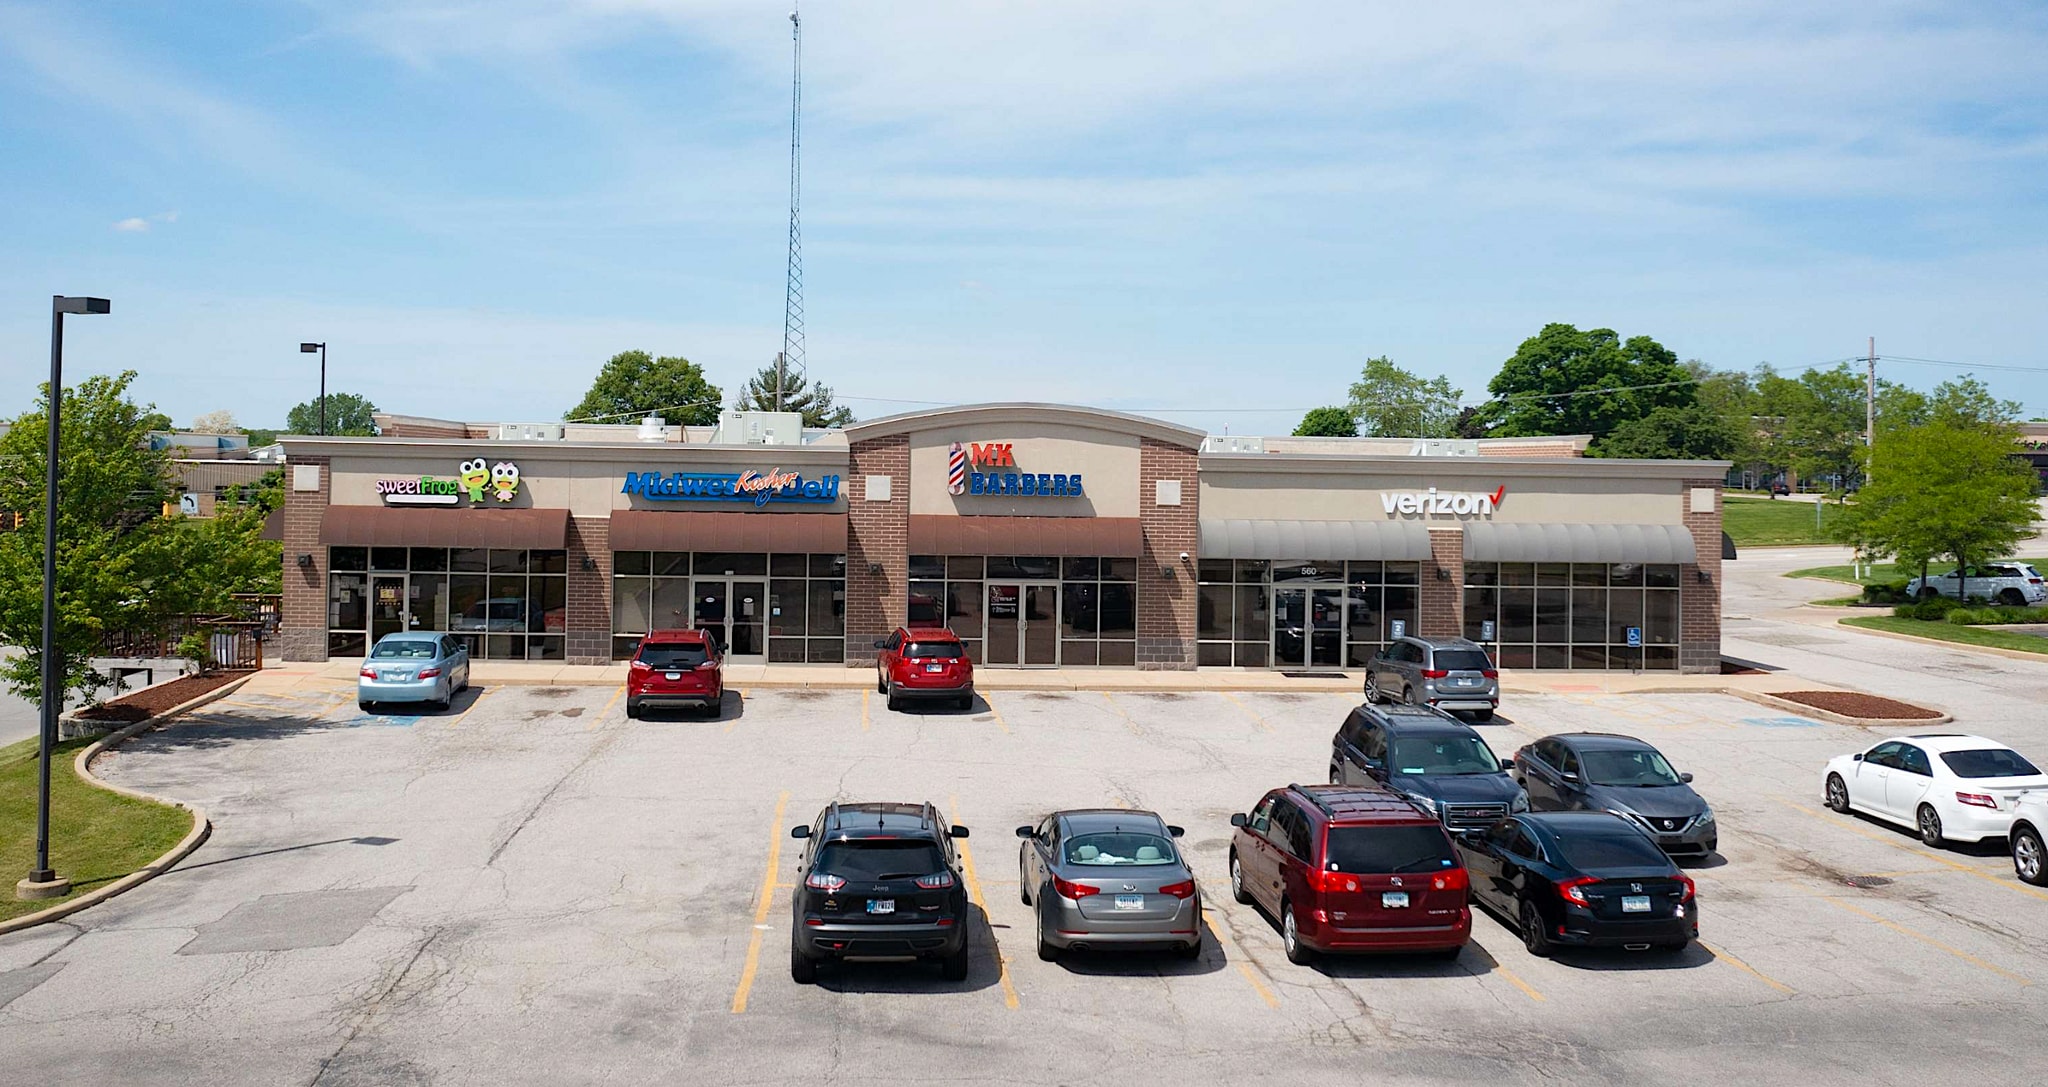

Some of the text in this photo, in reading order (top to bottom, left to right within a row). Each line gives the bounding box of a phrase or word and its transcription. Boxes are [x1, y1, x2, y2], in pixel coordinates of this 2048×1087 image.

[971, 443, 1013, 467] MK
[376, 476, 458, 494] sweetFrog
[734, 467, 798, 493] Kosher
[970, 472, 1082, 497] BARBERS
[1381, 487, 1491, 515] verizon
[1301, 567, 1317, 575] 560
[872, 884, 889, 892] Jeep
